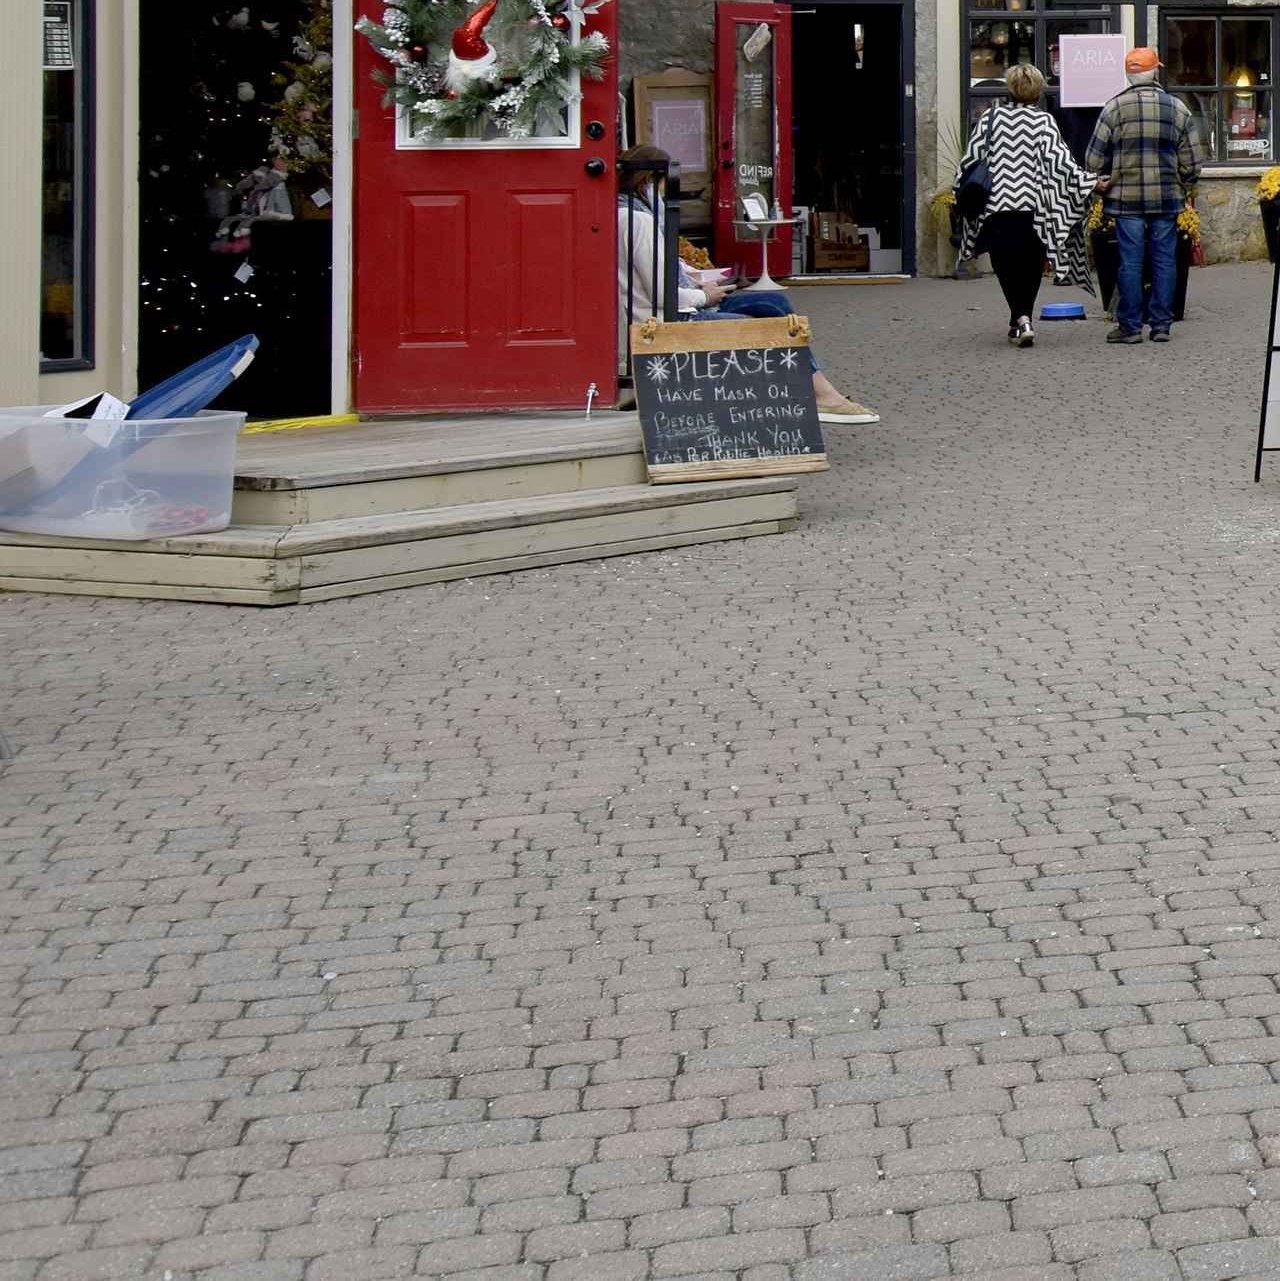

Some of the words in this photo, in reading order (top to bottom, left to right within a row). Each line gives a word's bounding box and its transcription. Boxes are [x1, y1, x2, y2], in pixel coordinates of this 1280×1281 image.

[1072, 50, 1116, 65] ARIA
[661, 123, 699, 136] ARIA
[670, 348, 775, 382] PLEASE
[657, 388, 703, 403] HAVE
[715, 386, 757, 401] MASK
[768, 385, 789, 398] ON
[729, 404, 806, 424] ENTERING
[698, 431, 759, 448] THANK
[767, 425, 805, 445] YOU
